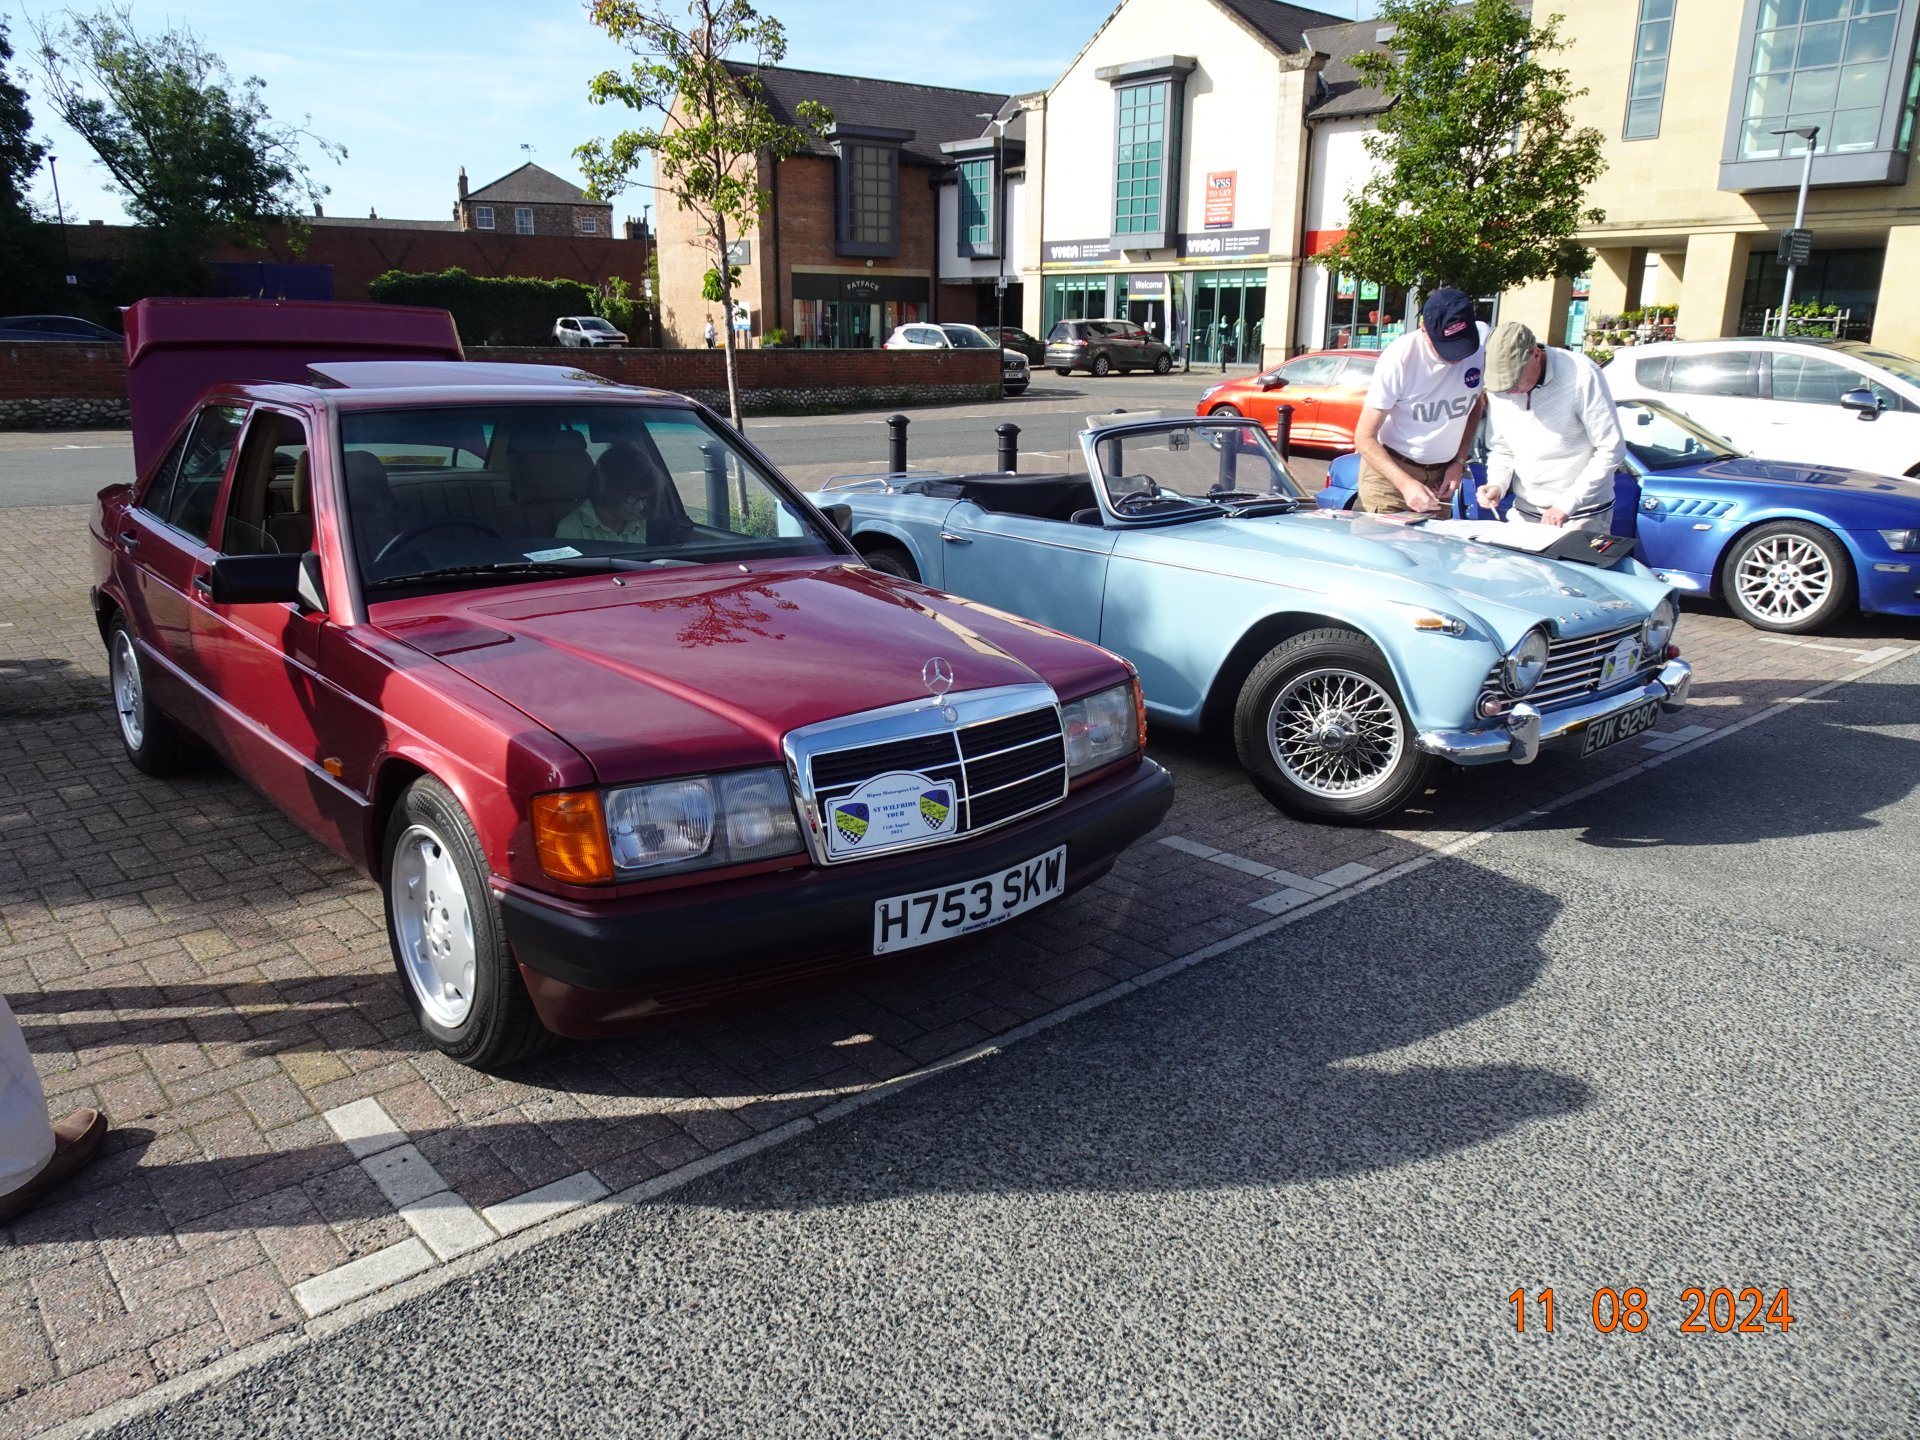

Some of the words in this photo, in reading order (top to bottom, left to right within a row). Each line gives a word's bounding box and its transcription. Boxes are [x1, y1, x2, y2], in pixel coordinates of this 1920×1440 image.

[1208, 190, 1218, 198] TO
[1219, 189, 1232, 197] LET
[1187, 238, 1221, 253] YMCA
[1051, 244, 1079, 259] YMCA
[846, 279, 880, 291] FATFACE
[1135, 280, 1163, 289] Welcome
[1584, 717, 1618, 754] EUK
[1618, 701, 1658, 738] 929C
[882, 788, 909, 796] Motorsport
[882, 801, 916, 811] WILFRIDS
[886, 811, 905, 819] TOUR
[894, 821, 909, 829] August
[881, 881, 993, 943] H753
[1002, 851, 1061, 909] SKW
